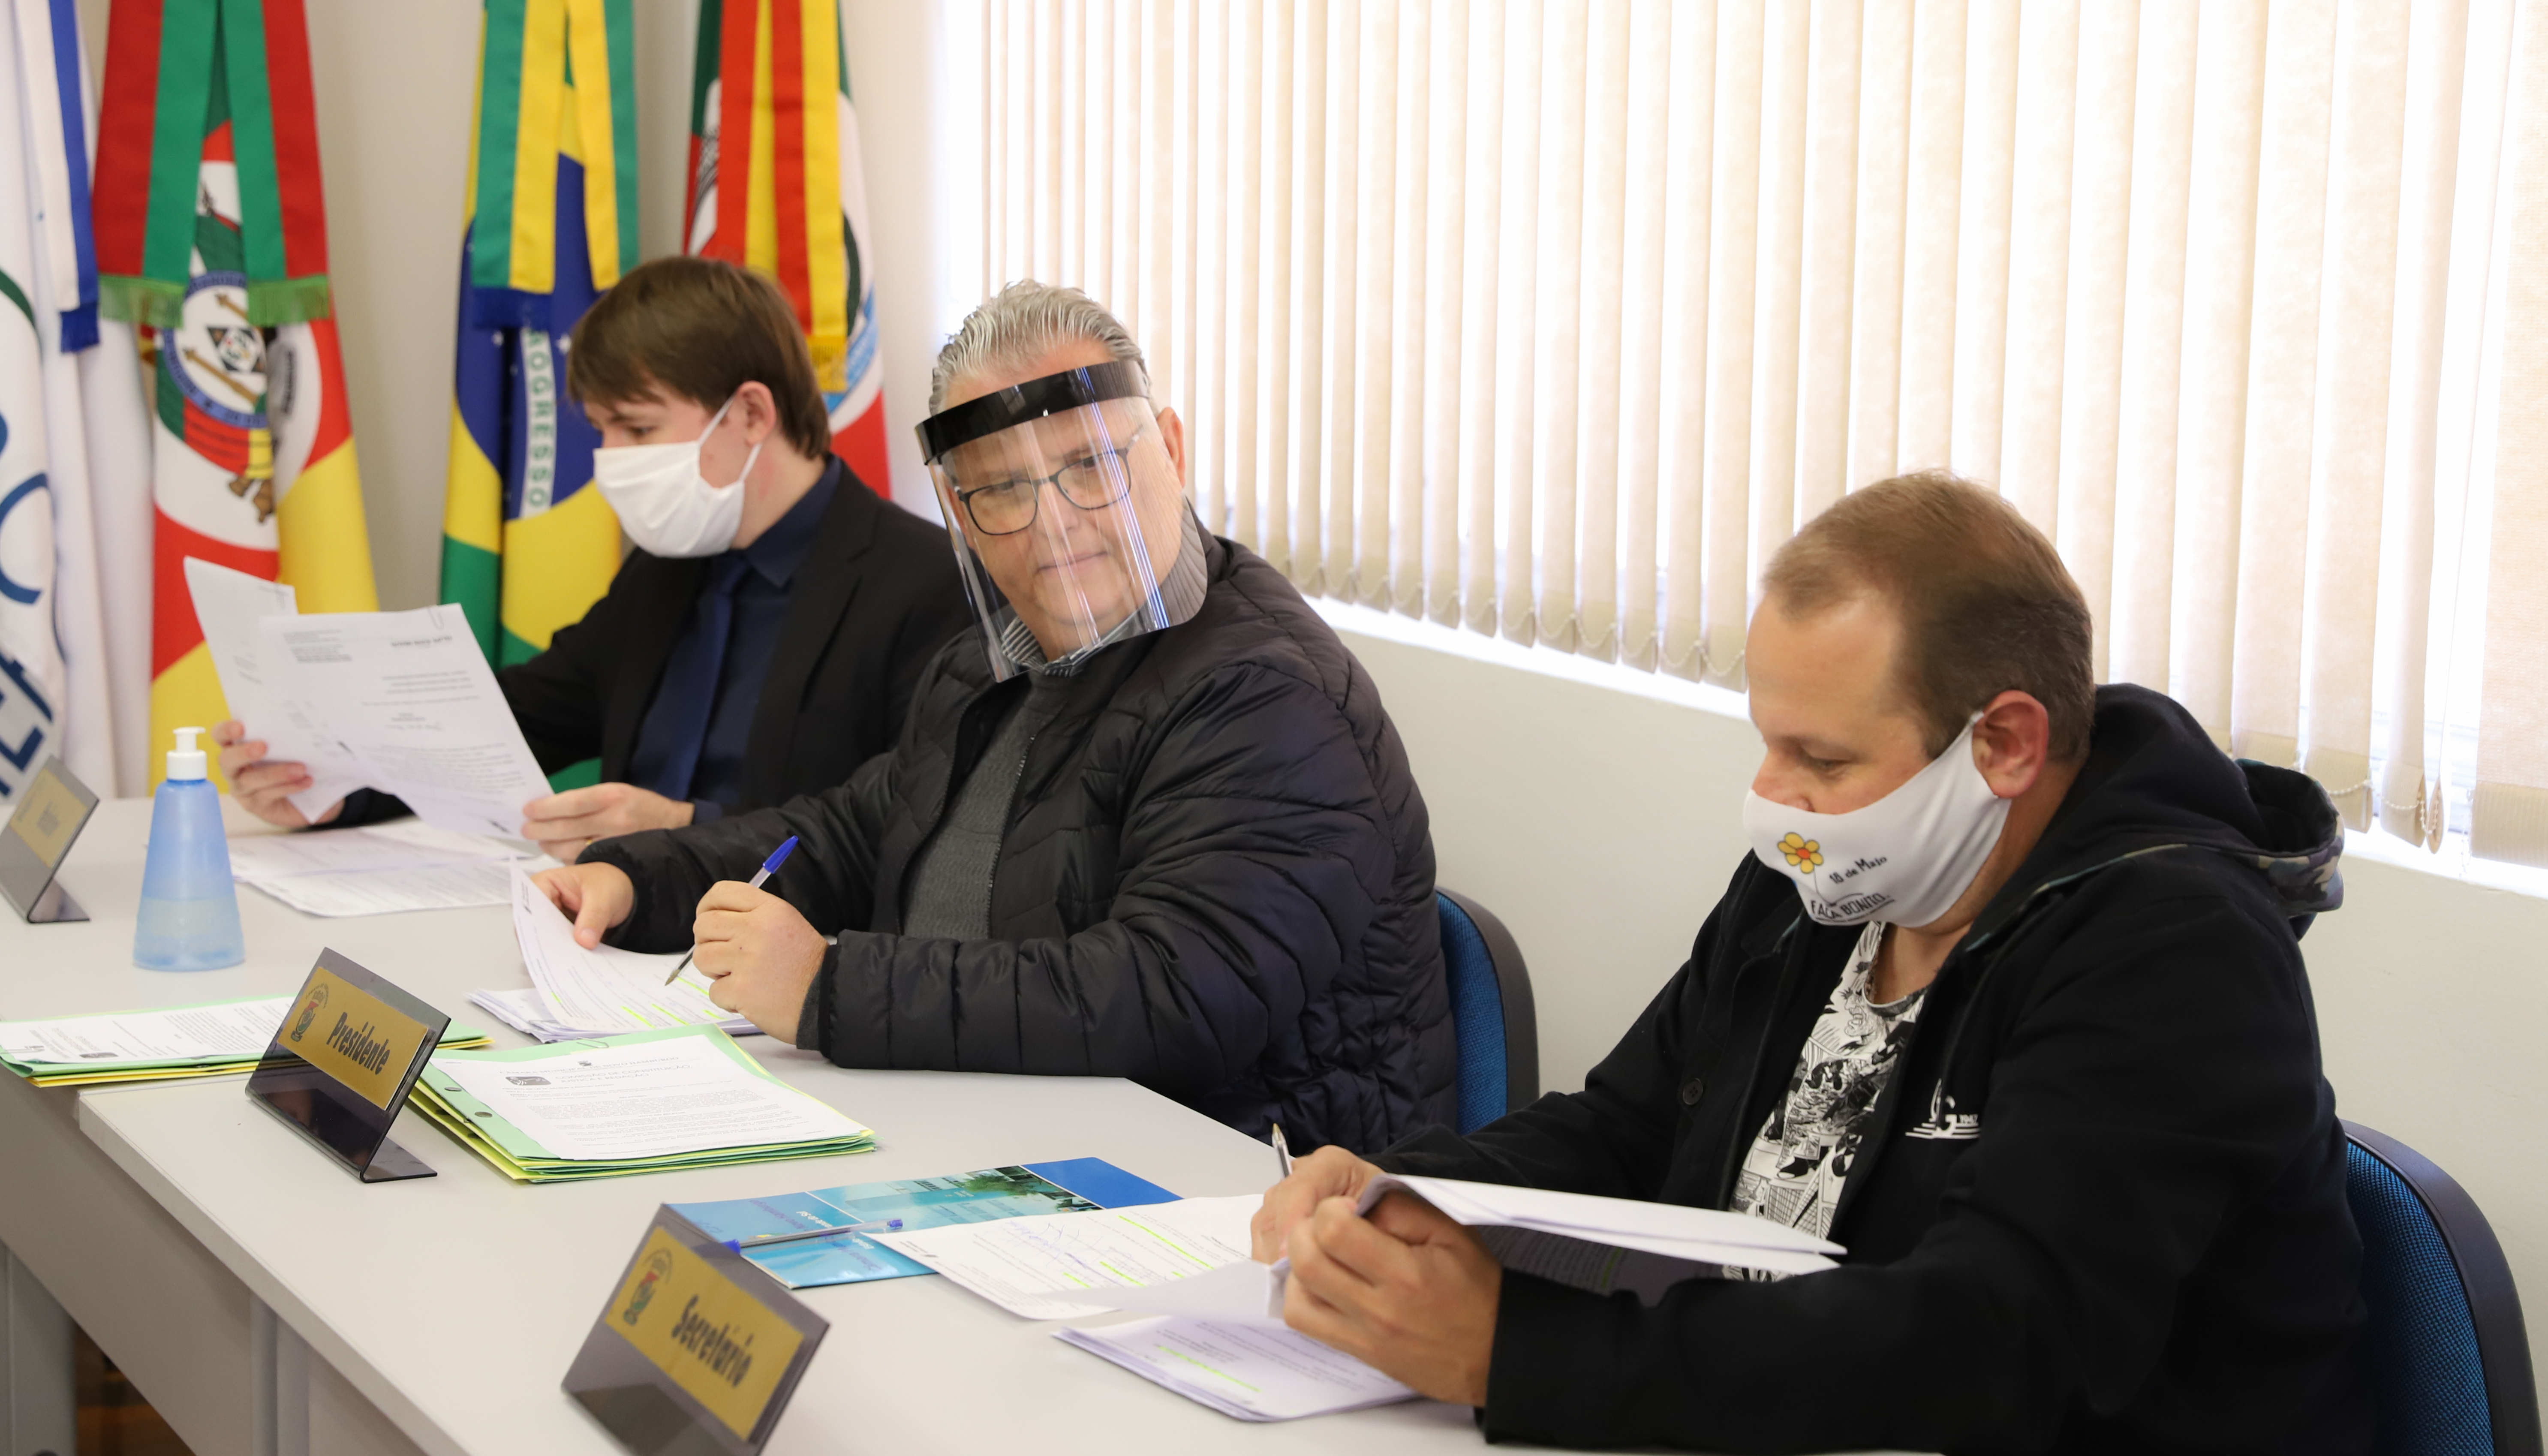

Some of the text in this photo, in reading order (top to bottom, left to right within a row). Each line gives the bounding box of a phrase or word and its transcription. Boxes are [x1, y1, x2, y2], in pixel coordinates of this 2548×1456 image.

[1829, 857, 1888, 884] 18 de Maio
[1810, 899, 1843, 919] FAÇA
[326, 1011, 391, 1075] Presidente
[629, 1056, 679, 1065] HAMBURGO
[671, 1293, 754, 1389] Secretário
